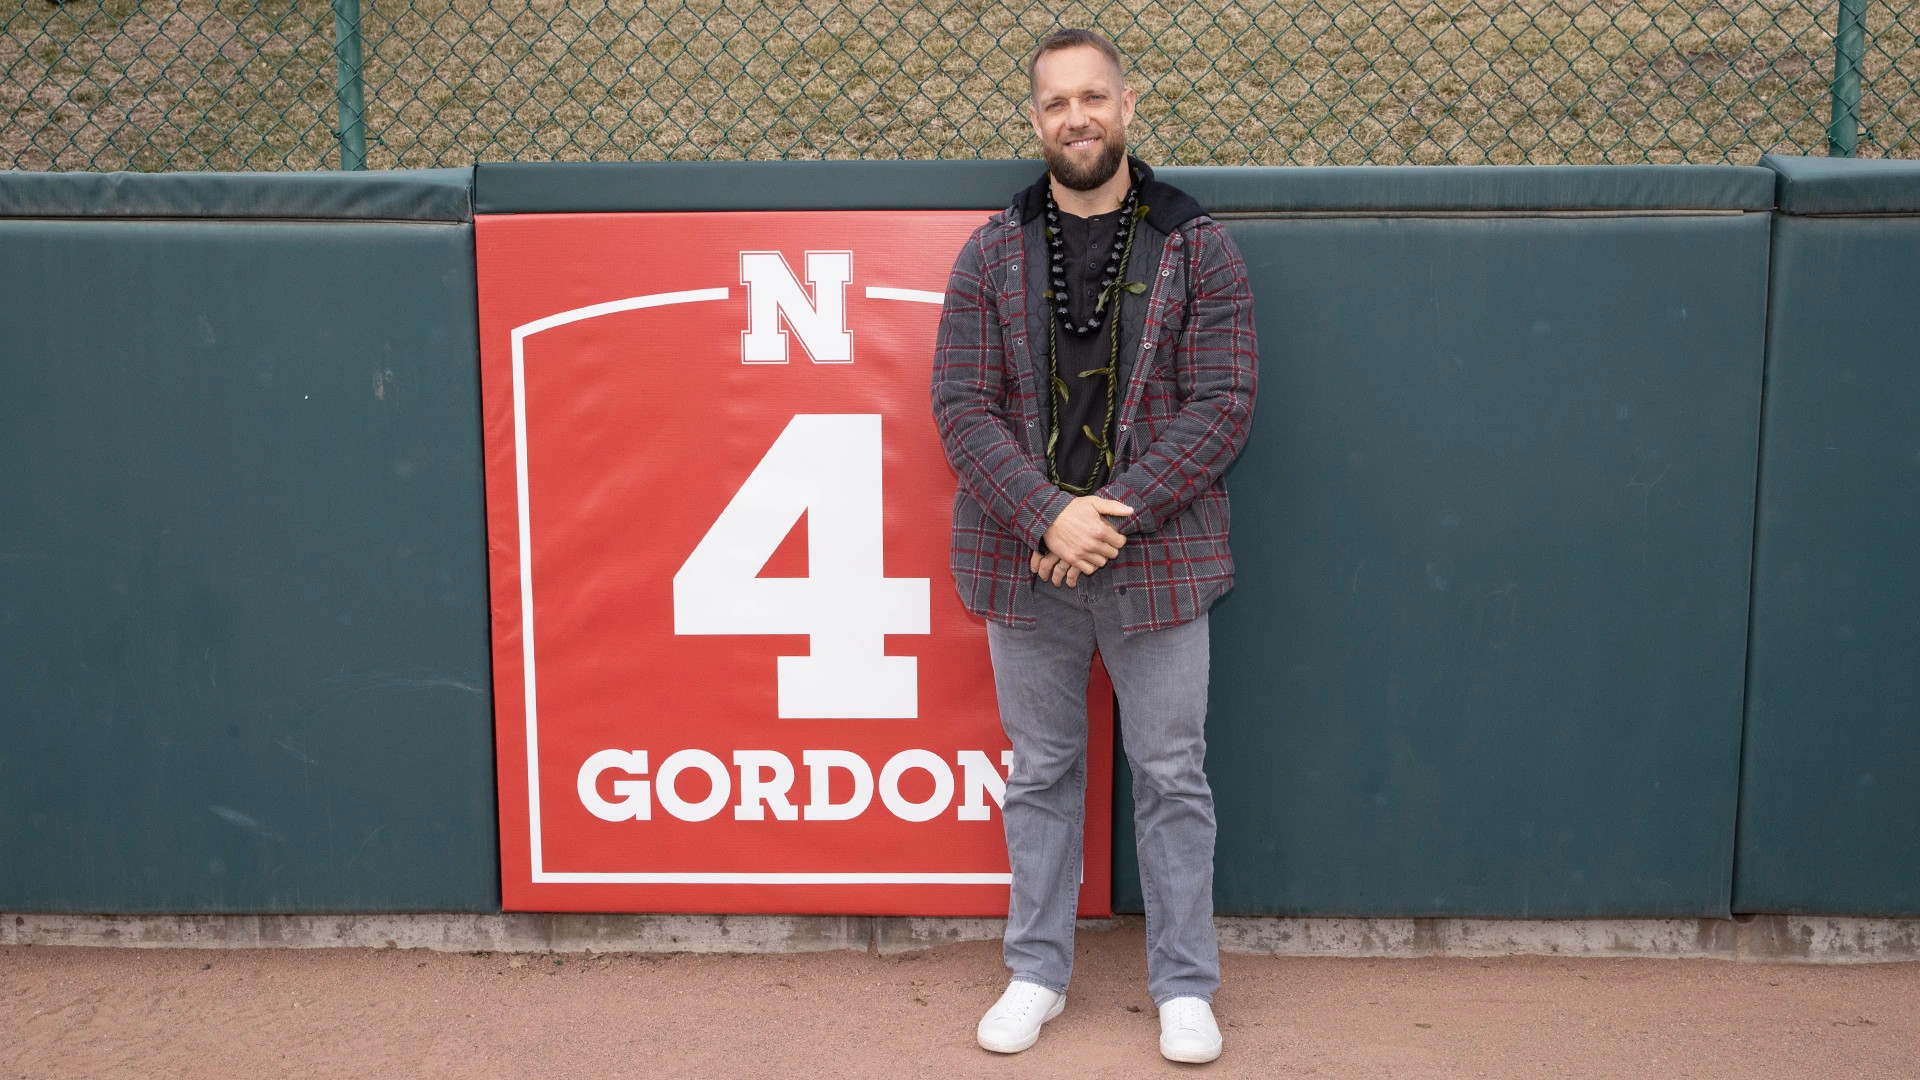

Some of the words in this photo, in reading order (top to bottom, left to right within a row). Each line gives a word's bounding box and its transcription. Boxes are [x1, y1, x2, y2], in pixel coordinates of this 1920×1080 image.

[739, 249, 854, 365] N
[672, 413, 931, 719] 4
[577, 748, 1014, 822] GORDON
